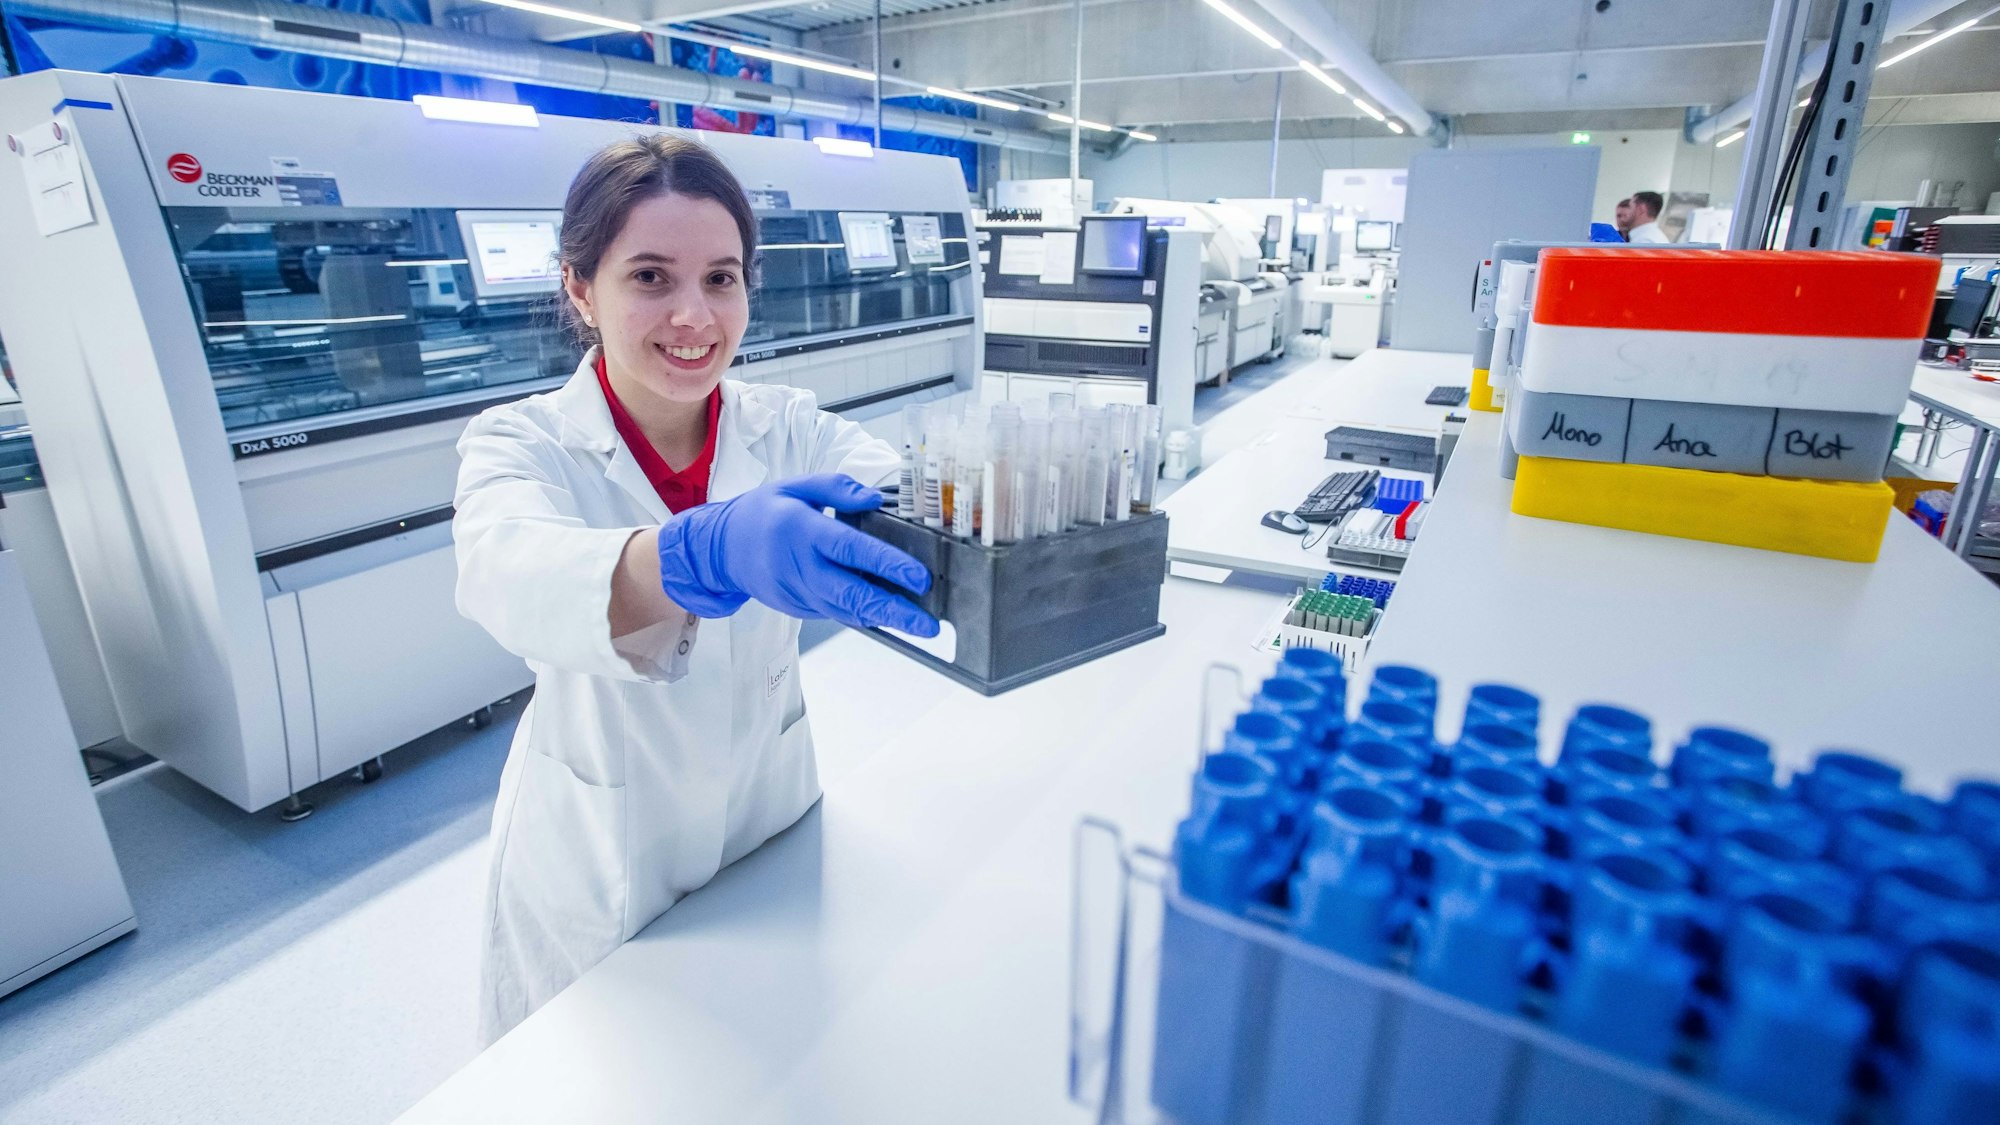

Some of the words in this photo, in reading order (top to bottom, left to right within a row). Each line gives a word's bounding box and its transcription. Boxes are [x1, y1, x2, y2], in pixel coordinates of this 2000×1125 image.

[197, 184, 262, 198] COULTER
[206, 172, 274, 187] BECKMAN
[1541, 411, 1603, 447] Mono
[1653, 423, 1718, 457] Ana
[240, 440, 271, 455] DxA
[271, 432, 309, 449] 5000
[1784, 429, 1855, 460] Blot
